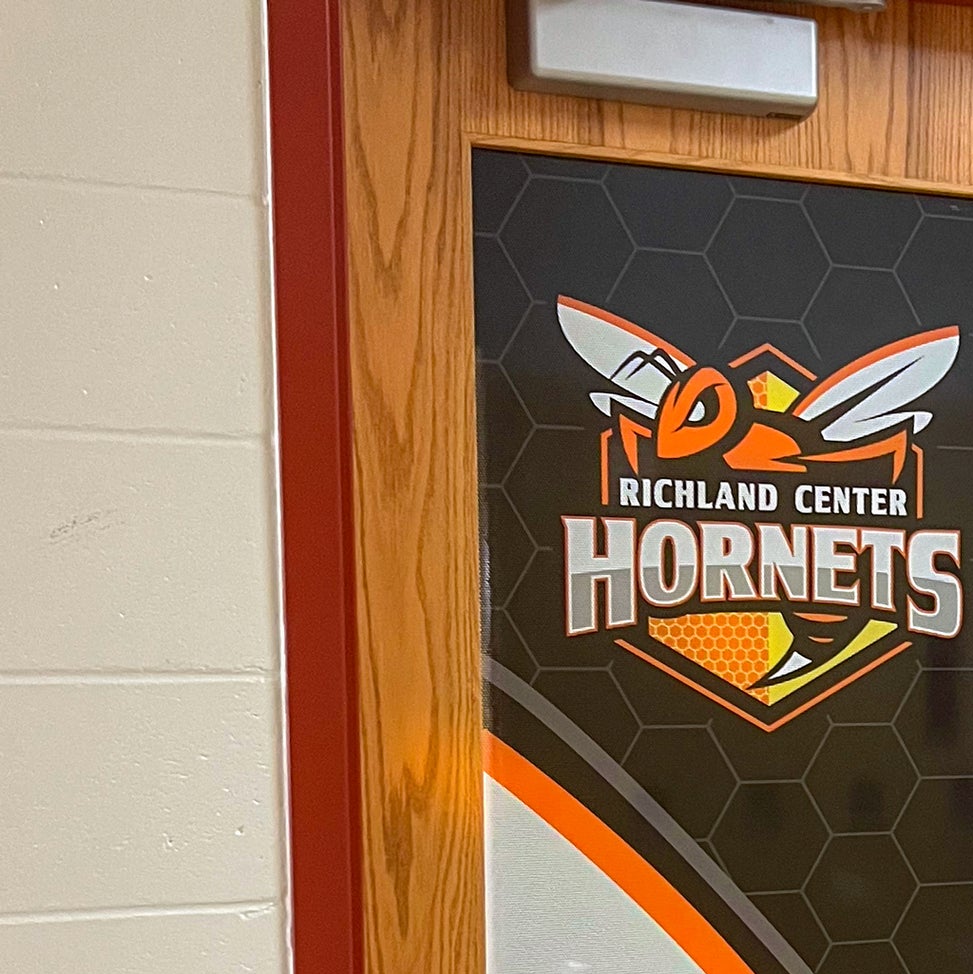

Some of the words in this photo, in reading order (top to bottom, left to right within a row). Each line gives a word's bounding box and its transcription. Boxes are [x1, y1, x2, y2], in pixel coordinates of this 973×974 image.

[618, 477, 778, 512] RICHLAND
[794, 484, 908, 517] CENTER
[560, 515, 964, 640] HORNETS
